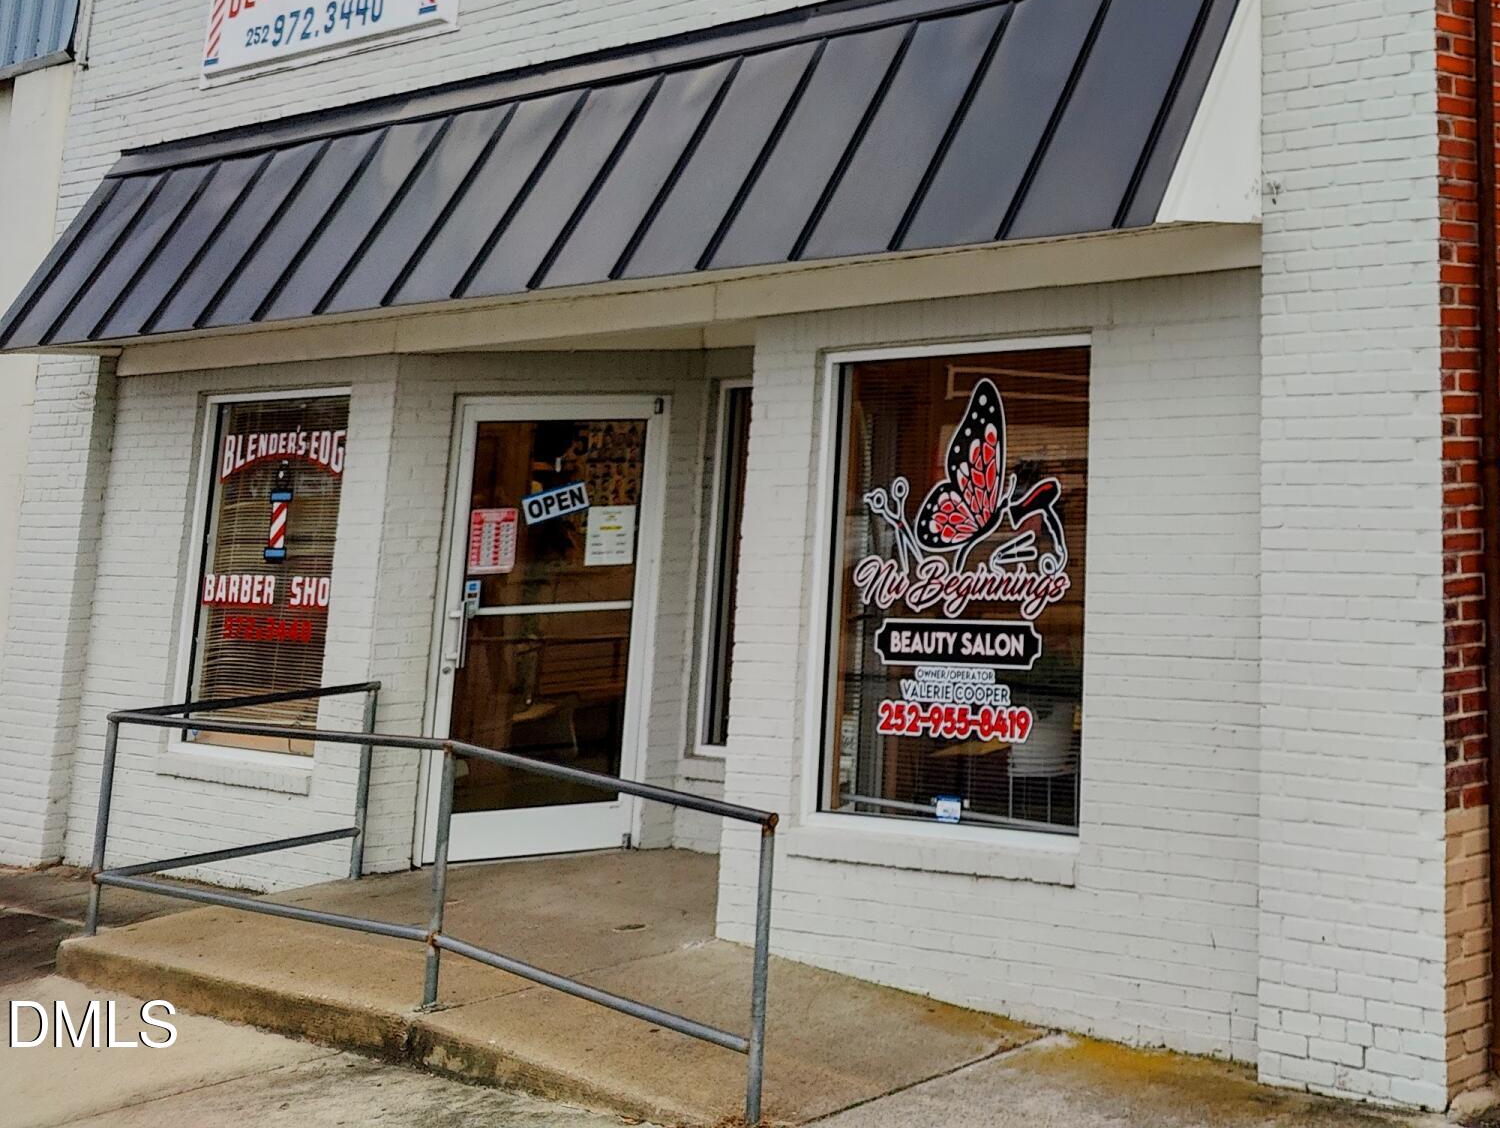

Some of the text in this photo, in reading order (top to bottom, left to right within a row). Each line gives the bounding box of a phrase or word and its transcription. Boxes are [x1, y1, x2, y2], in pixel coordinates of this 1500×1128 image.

[244, 24, 270, 47] 252
[221, 425, 346, 479] BLENDER'S EDG
[527, 486, 587, 519] OPEN
[203, 573, 331, 607] BARBER SHO
[855, 556, 1070, 618] Nu Beginnings
[890, 630, 1025, 657] BEAUTY SALON
[917, 668, 994, 681] OWNER/OPERATOR
[903, 683, 1009, 703] VALERIE COOPER
[879, 703, 1031, 739] 252-955-8419
